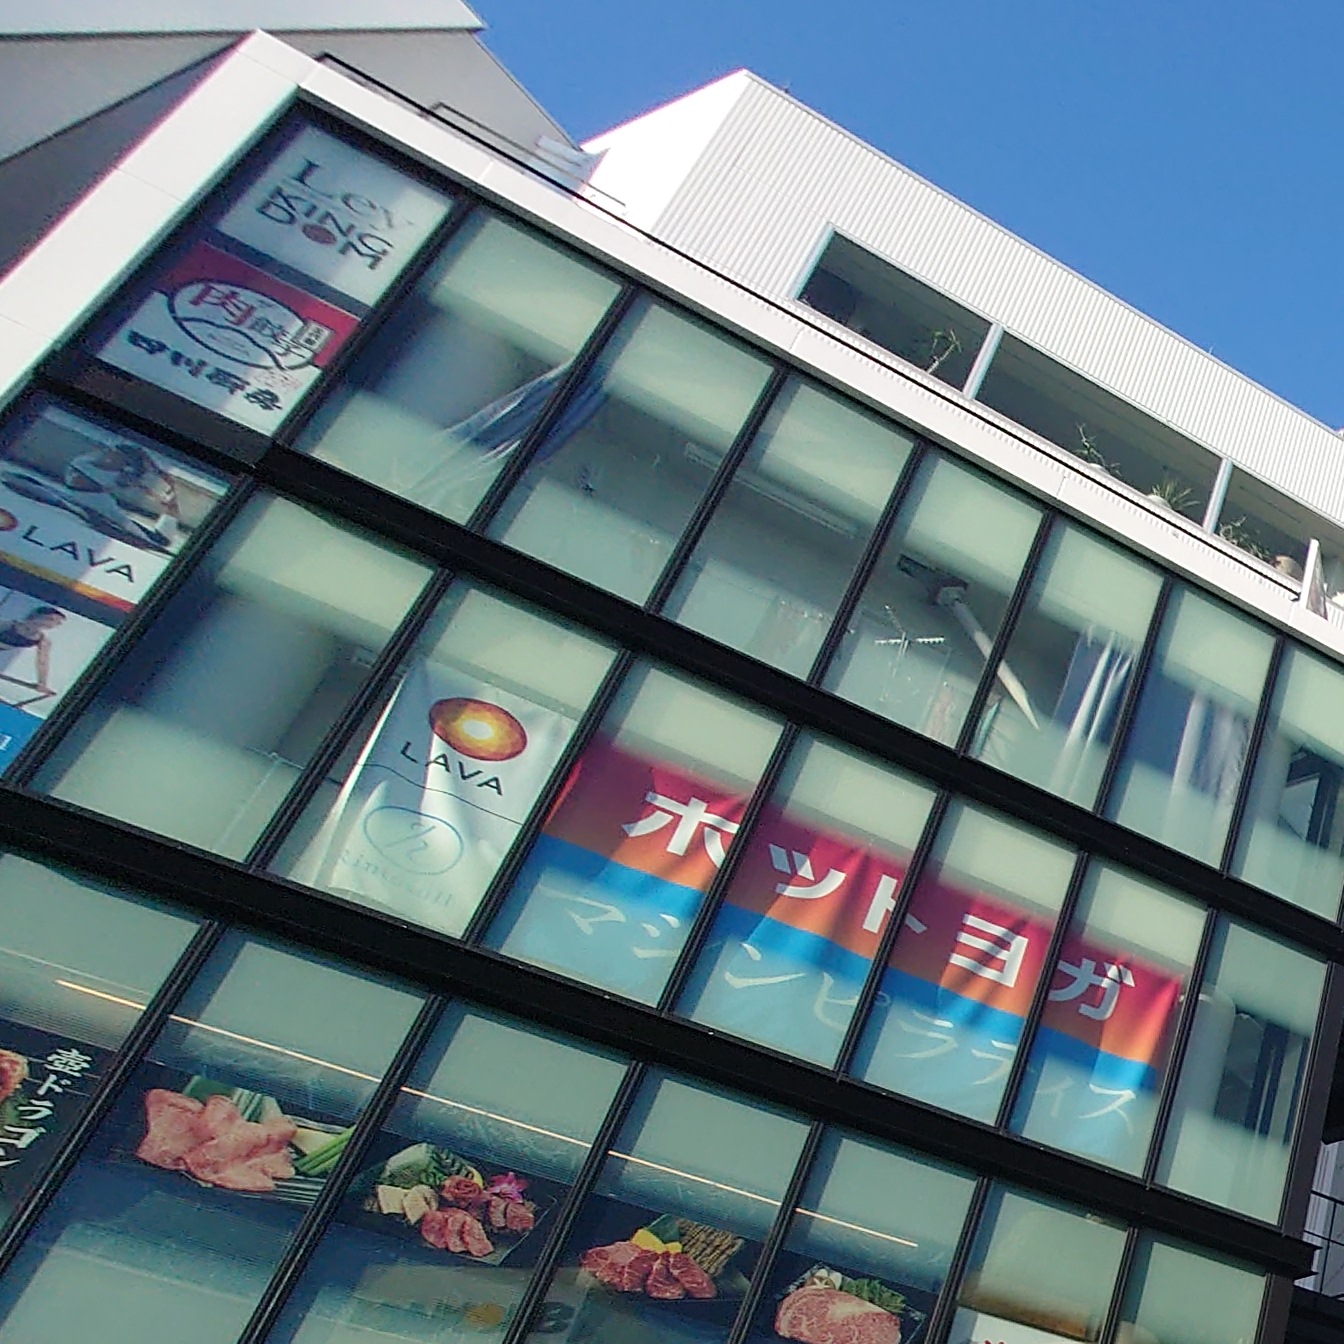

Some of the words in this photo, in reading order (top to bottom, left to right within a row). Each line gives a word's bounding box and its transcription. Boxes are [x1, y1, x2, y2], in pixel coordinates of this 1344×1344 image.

[22, 524, 135, 583] LAVA
[401, 741, 503, 796] LAVA
[621, 791, 1136, 1022] ホットヨガ
